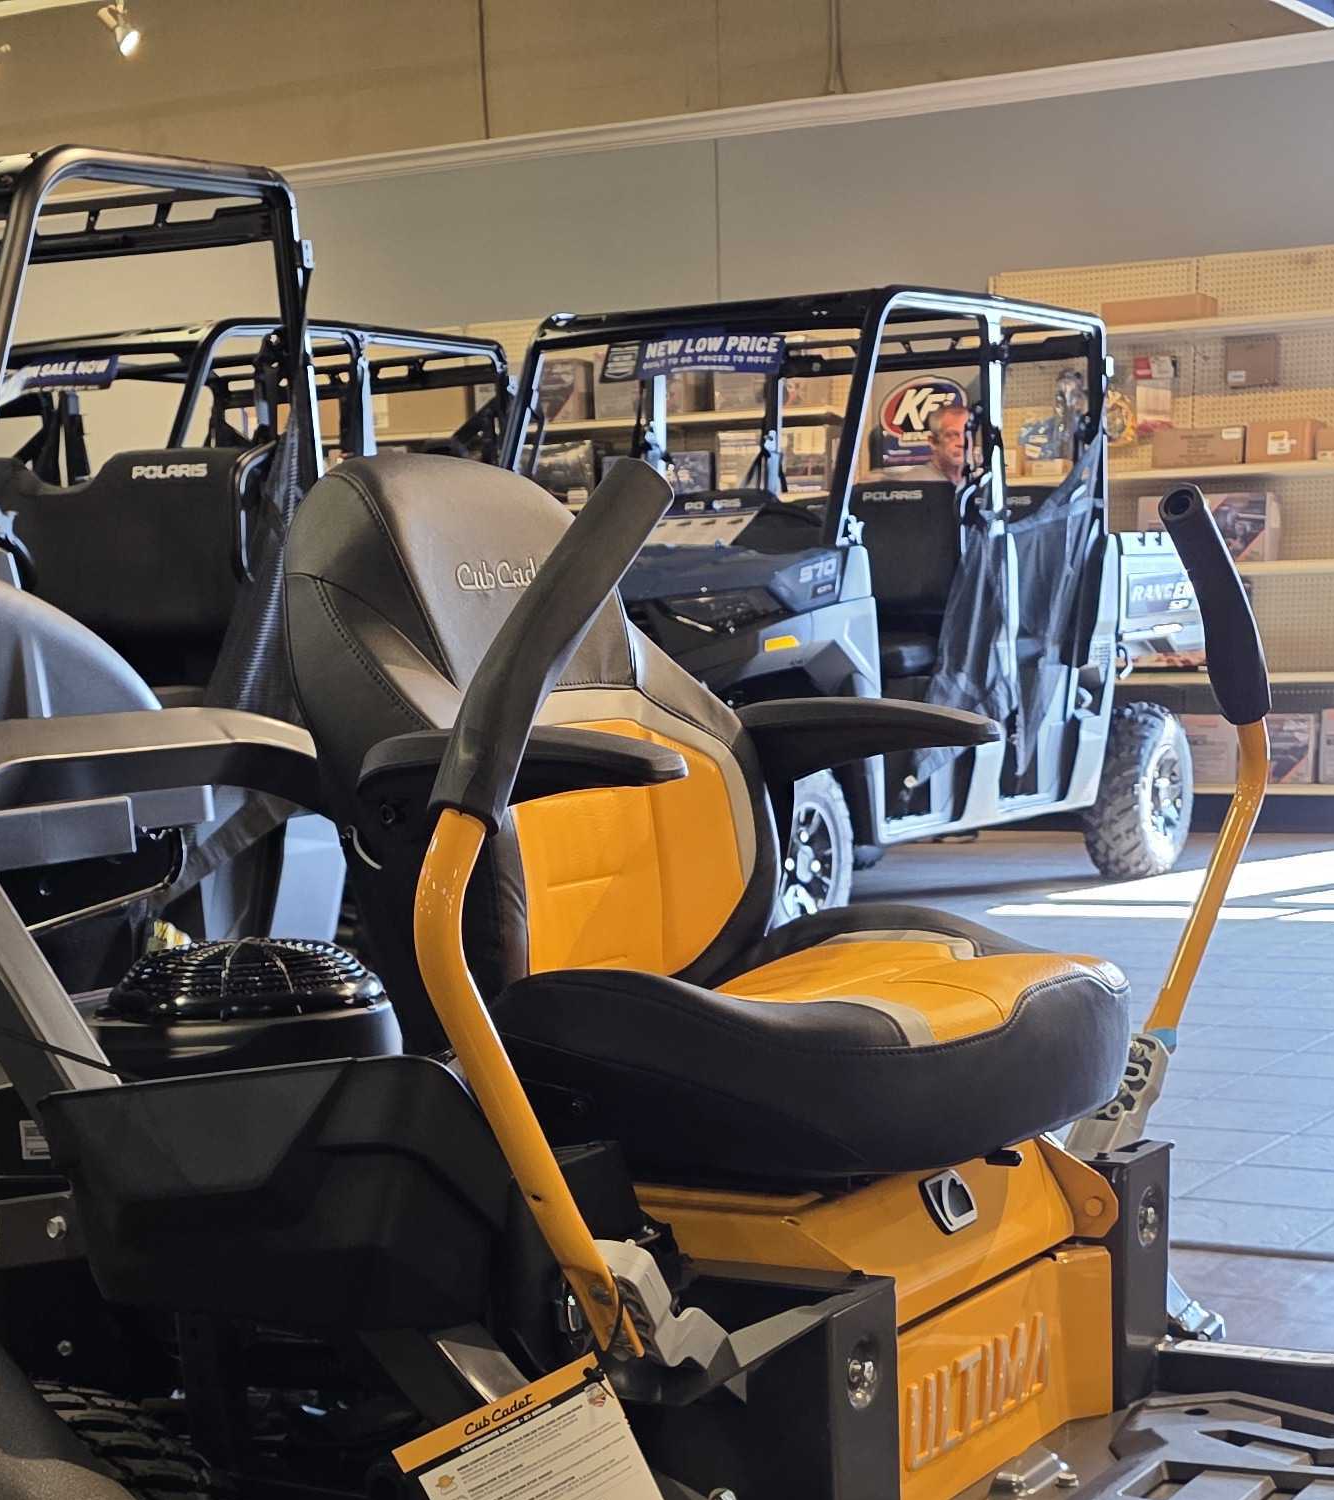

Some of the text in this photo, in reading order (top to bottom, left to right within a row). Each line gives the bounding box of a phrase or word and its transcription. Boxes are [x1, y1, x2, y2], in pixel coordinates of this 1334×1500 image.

[645, 339, 684, 359] NEW
[685, 336, 725, 354] LOW
[725, 335, 781, 353] PRICE
[39, 360, 78, 377] SALE
[75, 358, 111, 375] NOW
[131, 463, 208, 480] POLARIS
[862, 489, 924, 502] POLARIS
[455, 556, 537, 592] Cub Cad
[799, 557, 837, 584] 570
[904, 1310, 1050, 1473] ULTIMA
[463, 1415, 491, 1436] Cub
[490, 1393, 535, 1423] Cadet
